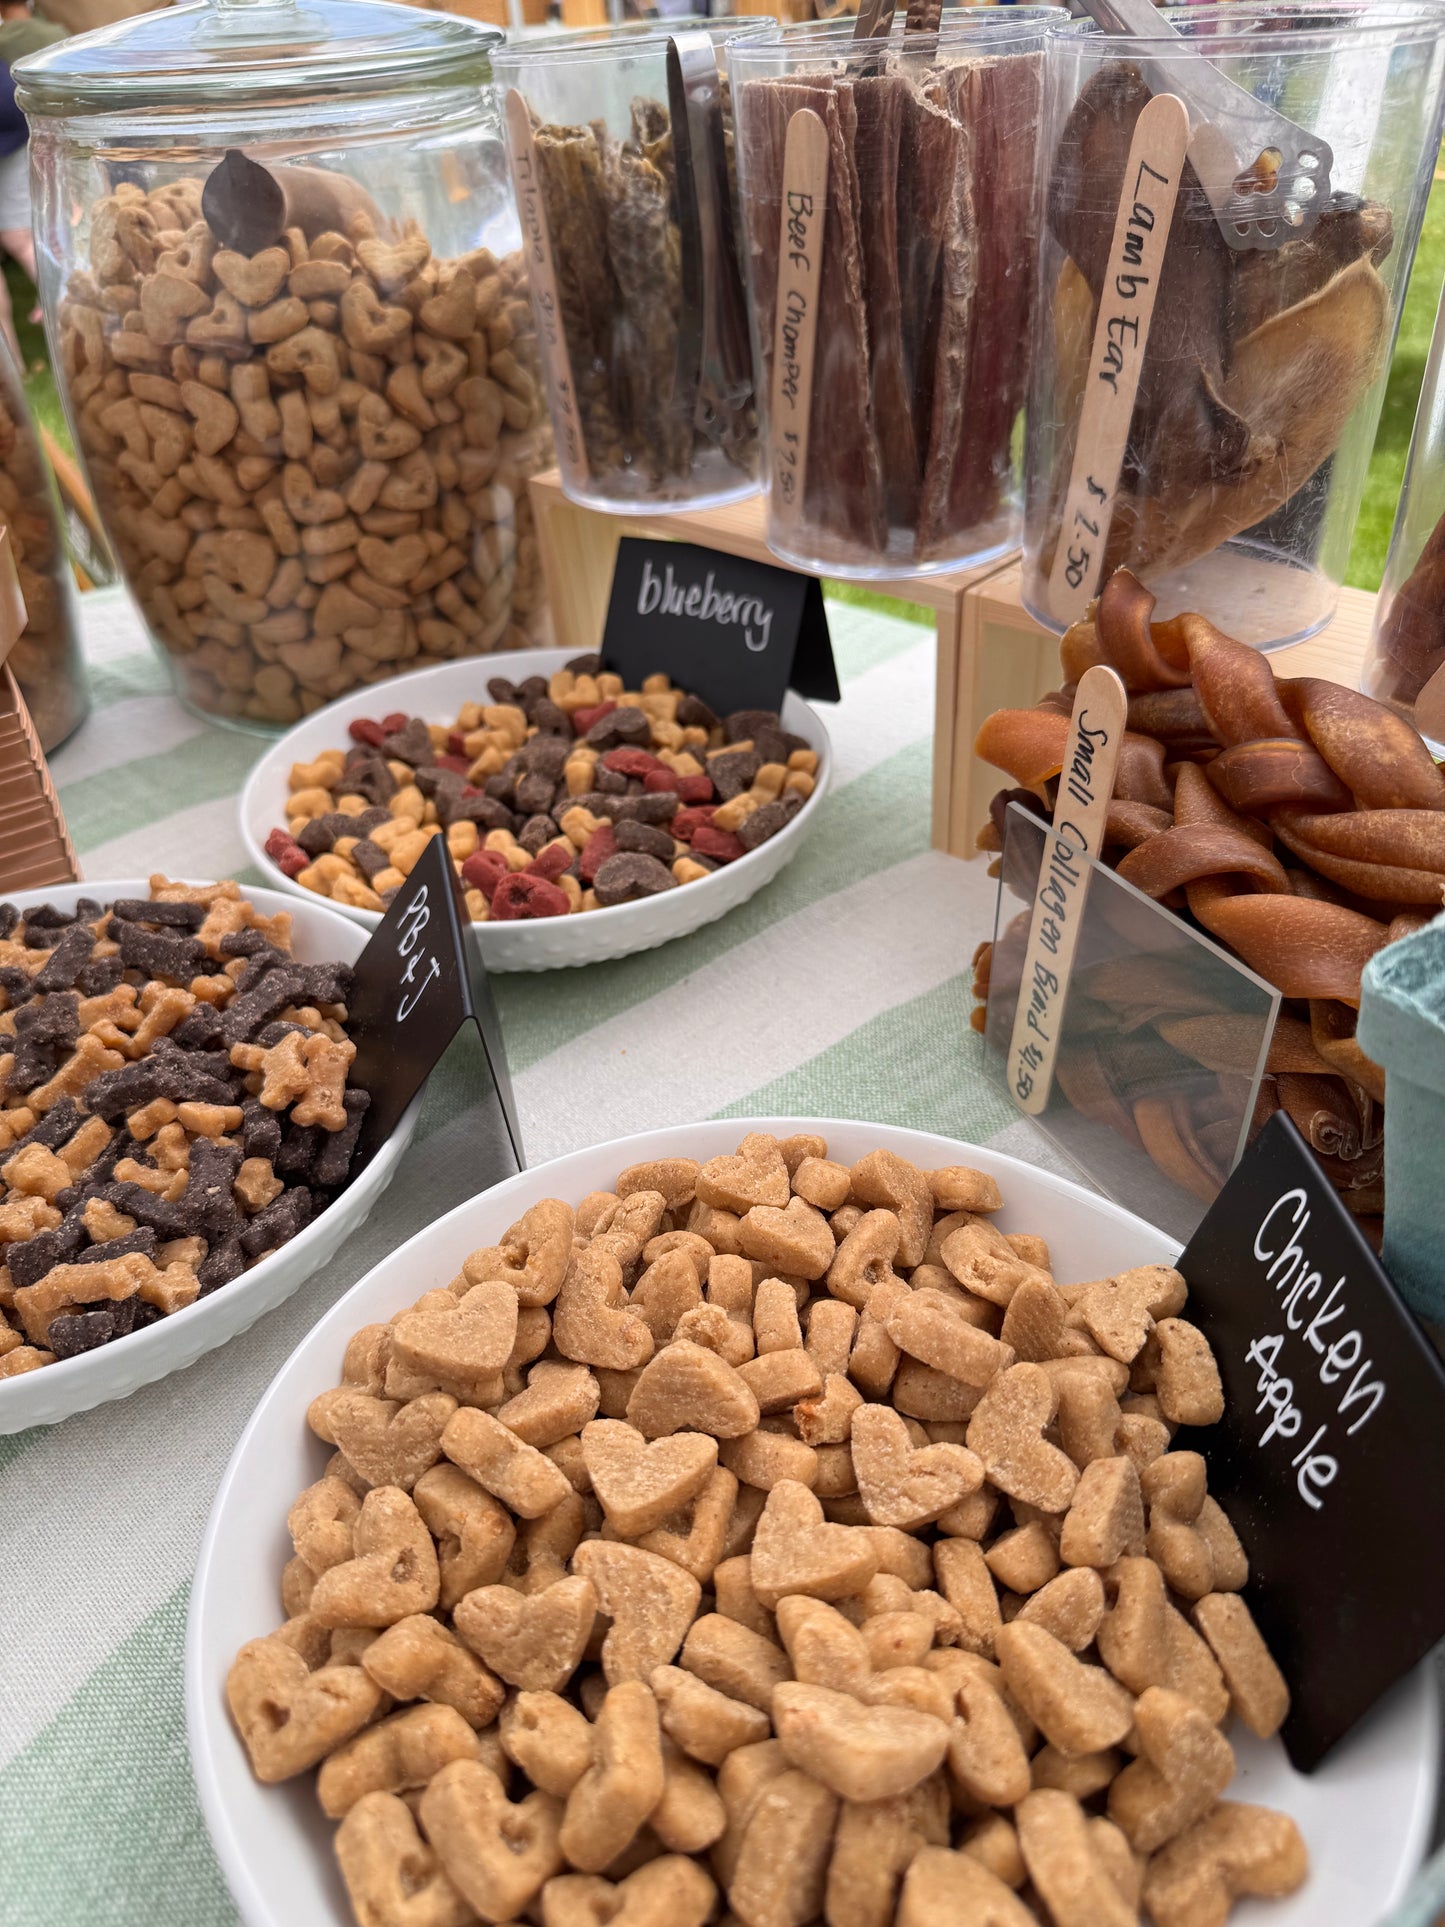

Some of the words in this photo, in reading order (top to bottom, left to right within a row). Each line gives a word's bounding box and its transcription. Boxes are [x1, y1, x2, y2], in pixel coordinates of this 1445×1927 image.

[786, 190, 814, 272] Beef
[1115, 159, 1170, 300] Lamb
[1099, 314, 1140, 395] Ear
[637, 559, 774, 652] blueberry
[1068, 708, 1108, 807] Small
[1039, 820, 1089, 955] Collagen
[1026, 960, 1059, 1042] Braid
[1015, 1041, 1047, 1101] $4.50
[1253, 1187, 1387, 1436] Chicken
[1244, 1333, 1340, 1512] Apple
